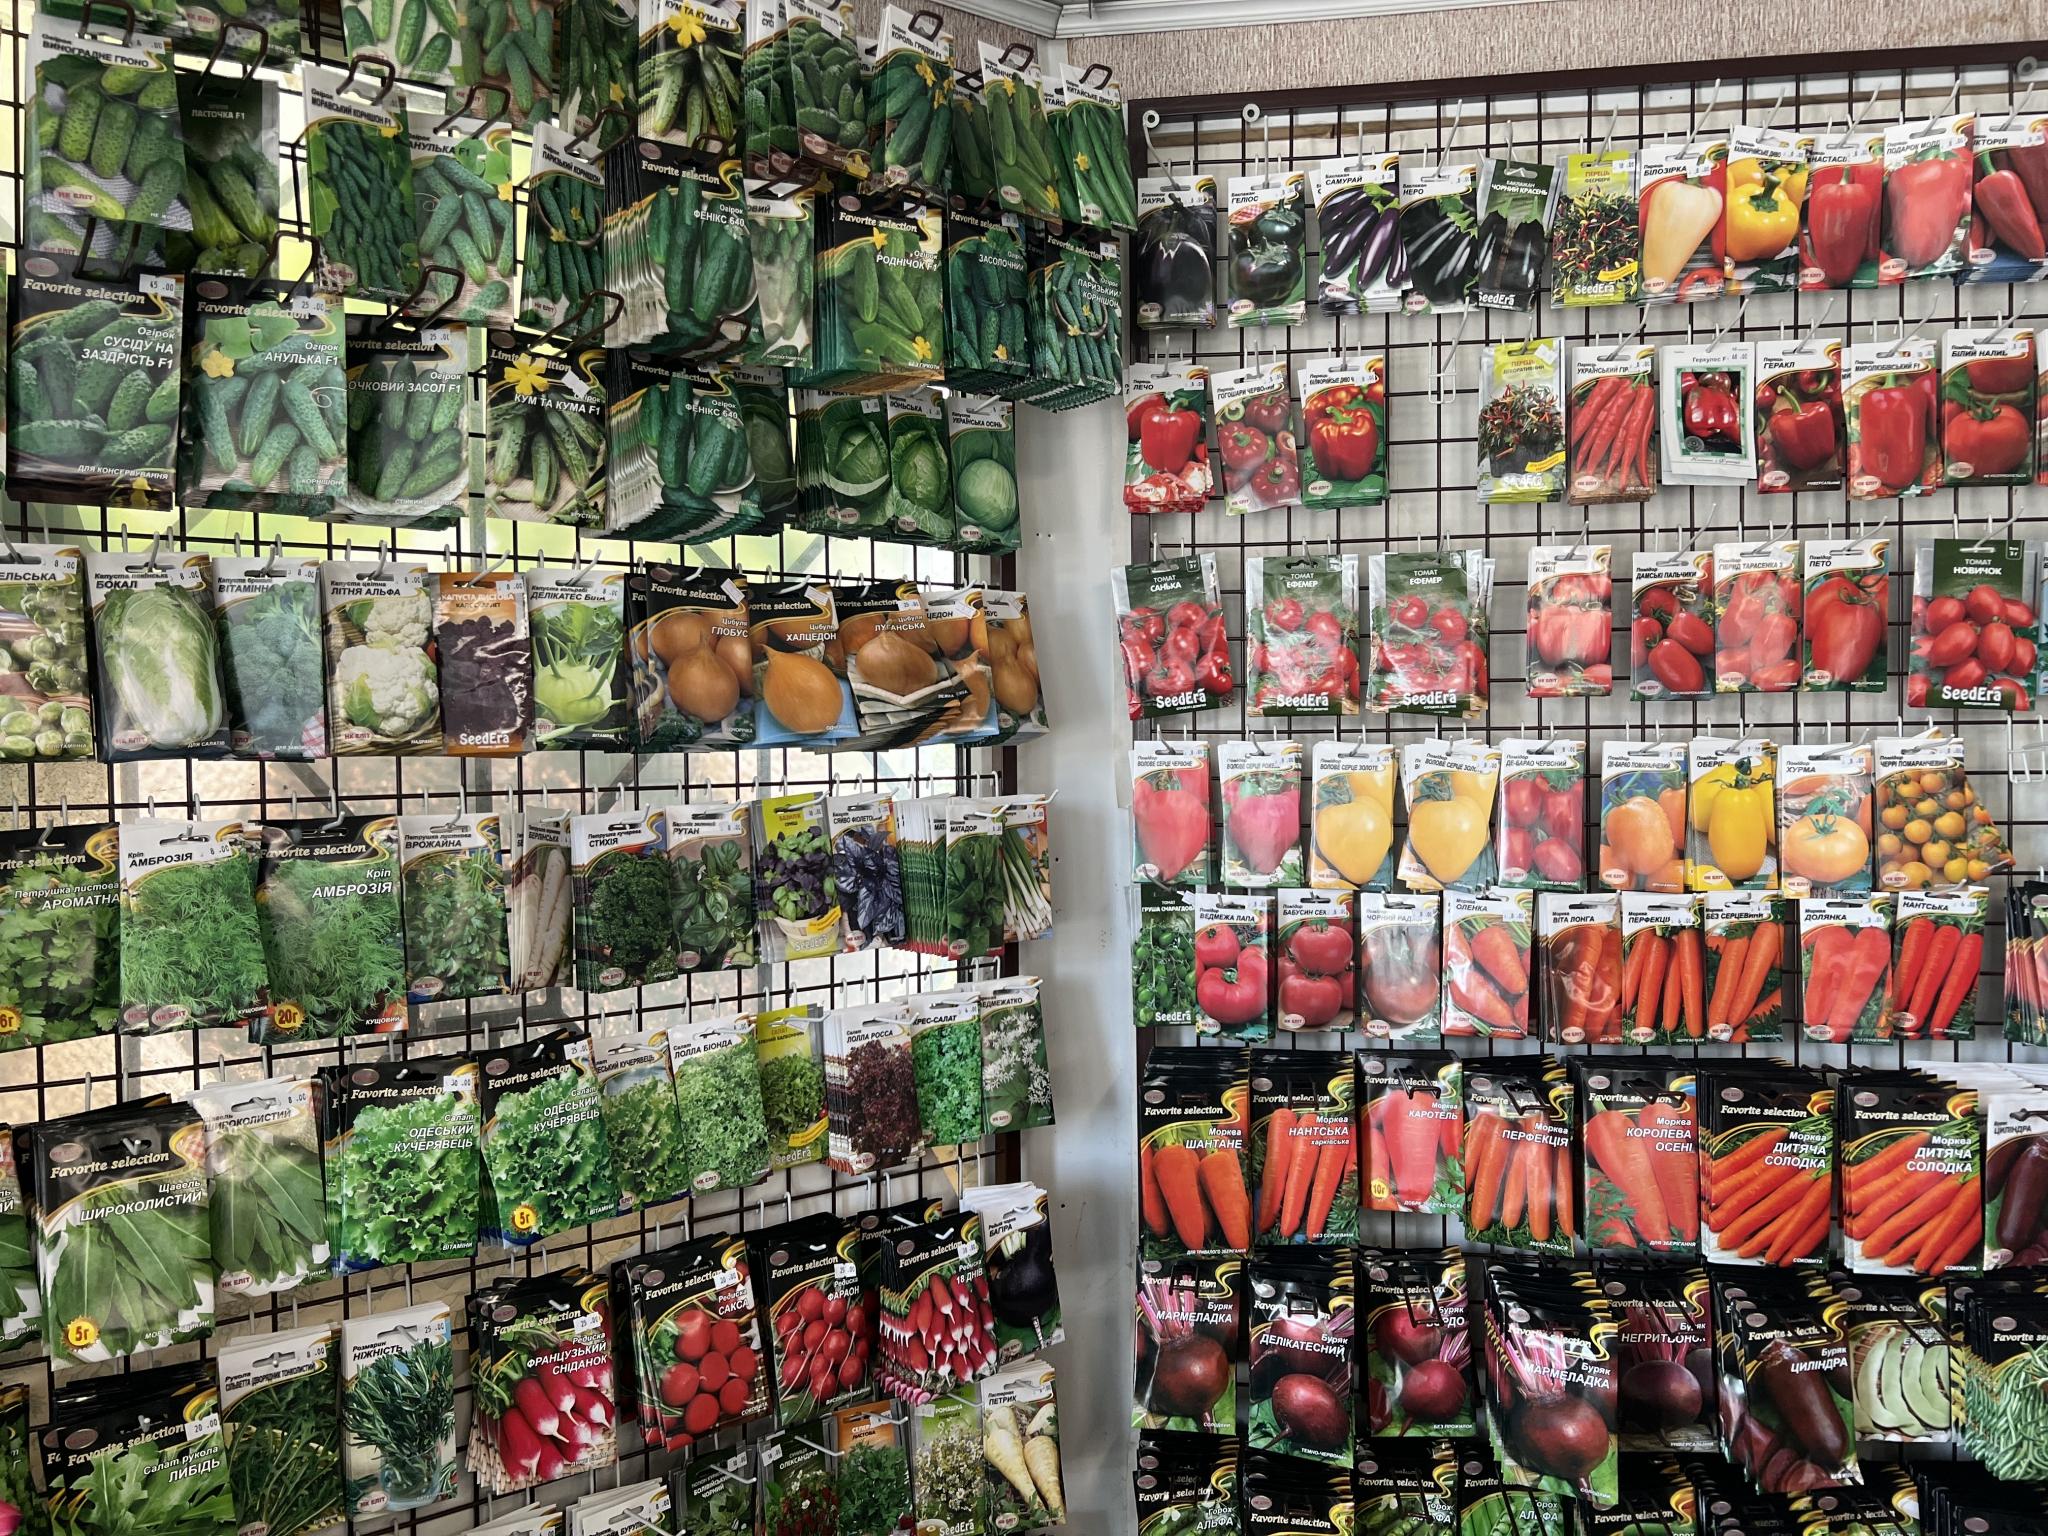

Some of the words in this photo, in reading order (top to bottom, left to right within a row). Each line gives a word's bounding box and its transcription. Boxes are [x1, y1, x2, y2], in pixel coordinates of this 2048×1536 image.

[114, 56, 149, 68] ГРОНО
[192, 110, 232, 119] ЛАСТОЧКА
[235, 111, 245, 120] F1
[1887, 144, 1918, 154] ПОДАРОК
[1326, 176, 1362, 185] САМУРАЙ
[1492, 183, 1519, 193] ЧОРНИЙ
[1520, 187, 1548, 196] КРАСЕНЬ
[719, 204, 743, 214] Огірок
[693, 209, 728, 225] ФЕНІКС
[729, 217, 745, 227] 640
[839, 212, 876, 226] Favorite
[878, 220, 917, 233] selection
[876, 254, 922, 269] РОДНІЧОК
[23, 278, 82, 297] Favorite
[86, 287, 145, 304] selection
[137, 327, 175, 339] Огірок
[104, 336, 154, 352] СУСІДУ
[156, 341, 173, 354] НА
[306, 342, 338, 352] Огірок
[81, 348, 154, 366] ЗАЗДРІСТЬ
[158, 357, 173, 368] F1
[265, 352, 322, 365] АНУЛЬКА
[326, 355, 338, 365] F1
[1763, 361, 1795, 369] ГЕРАКЛ
[431, 372, 461, 381] Огірок
[408, 382, 445, 393] ЗАСОЛ
[448, 383, 460, 393] F1
[515, 393, 538, 405] КУМ
[540, 396, 555, 407] ТА
[556, 399, 586, 412] КУМА
[588, 404, 601, 415] F1
[711, 400, 736, 408] Огірок
[685, 404, 719, 418] ФЕНІКС
[722, 410, 738, 419] 640
[1636, 572, 1663, 580] ДАМСЬКІ
[1665, 571, 1696, 579] ПАЛЬЧИКИ
[1953, 566, 2002, 575] НОВИЧОК
[96, 580, 138, 589] БОКАЛ
[1154, 575, 1176, 583] ТОМАТ
[1286, 580, 1318, 589] ЕФЕМЕР
[1410, 577, 1442, 585] ЕФЕМЕР
[331, 586, 362, 597] ЛІТНЯ
[365, 588, 401, 597] АЛЬФА
[1150, 582, 1182, 592] САНЬКА
[531, 591, 583, 601] ДЕЛІКАТЕС
[722, 617, 747, 627] Цибуля
[810, 623, 834, 632] Цибуля
[875, 622, 926, 632] ЛУГАНСЬКА
[711, 626, 748, 638] ГЛОБУС
[786, 630, 836, 642] ХАЛЦЕДОН
[673, 827, 699, 835] РУТАН
[405, 839, 462, 848] ВРОЖАЙНА
[589, 838, 618, 847] СТИХІЯ
[314, 843, 366, 856] selection
[130, 852, 193, 868] АМБРОЗІЯ
[366, 869, 391, 880] Кріп
[15, 886, 71, 899] Петрушка
[312, 881, 392, 899] АМБРОЗІЯ
[42, 894, 120, 911] АРОМАТНА
[1456, 904, 1488, 912] ОЛЕНКА
[1903, 901, 1949, 911] НАНТСЬКА
[1200, 913, 1234, 921] ВЕДМЕЖА
[1236, 914, 1255, 922] ЛАПА
[1570, 915, 1595, 923] ЛОНГА
[1805, 913, 1846, 921] ДОЛЯНКА
[278, 1011, 297, 1026] 20г
[847, 1033, 868, 1043] ЛОЛЛА
[870, 1030, 893, 1039] РОССА
[699, 1040, 729, 1053] БІОНДА
[543, 1095, 598, 1117] ОДЕСЬКИЙ
[1145, 1106, 1182, 1116] Favorite
[1184, 1106, 1223, 1115] selection
[1431, 1102, 1457, 1110] Морква
[1721, 1105, 1761, 1116] Favorite
[1763, 1107, 1807, 1118] selection
[445, 1114, 474, 1123] Салат
[534, 1109, 600, 1133] КУЧЕРЯВЕЦЬ
[1316, 1115, 1348, 1124] Морква
[1408, 1110, 1457, 1120] КАРОТЕЛЬ
[1855, 1110, 1900, 1120] Favorite
[1903, 1111, 1949, 1122] selection
[1656, 1117, 1691, 1127] Морква
[409, 1124, 474, 1138] ОДЕСЬКИЙ
[1209, 1127, 1241, 1137] Морква
[1289, 1126, 1349, 1137] НАНТСЬКА
[1535, 1123, 1568, 1135] Морква
[1626, 1127, 1691, 1139] КОРОЛЕВА
[1502, 1129, 1568, 1147] ПЕРФЕКЦІЯ
[1789, 1132, 1827, 1142] Морква
[1932, 1136, 1972, 1146] Морква
[393, 1138, 473, 1153] КУЧЕРЯВЕЦЬ
[1185, 1138, 1242, 1149] ШАНТАНЕ
[1655, 1141, 1693, 1152] ОСЕНІ
[1773, 1143, 1827, 1156] ДИТЯЧА
[1915, 1147, 1972, 1160] ДИТЯЧА
[50, 1161, 107, 1178] Favorite
[111, 1151, 169, 1167] selection
[1764, 1156, 1826, 1169] СОЛОДКА
[1907, 1161, 1972, 1173] СОЛОДКА
[159, 1179, 201, 1192] Щавель
[81, 1190, 202, 1221] ШИРОКОЛИСТИЙ
[989, 1224, 1013, 1237] БАГІРА
[956, 1274, 964, 1284] 18
[965, 1268, 983, 1282] ДНІВ
[828, 1286, 860, 1302] ФАРАОН
[719, 1299, 749, 1315] САКСА
[1208, 1301, 1233, 1311] Буряк
[540, 1309, 581, 1325] selection
[1157, 1311, 1232, 1323] МАРМЕЛАДКА
[75, 1328, 90, 1341] 5г
[572, 1331, 605, 1345] Редиска
[1321, 1333, 1348, 1345] Буряк
[1260, 1333, 1346, 1358] ДЕЛІКАТЕСНИЙ
[353, 1344, 403, 1362] НІЖНІСТЬ
[526, 1341, 606, 1369] ФРАНЦУЗЬКИЙ
[1822, 1347, 1847, 1357] Буряк
[552, 1354, 608, 1376] СНІДАНОК
[1581, 1361, 1611, 1375] Буряк
[1791, 1357, 1848, 1373] ЦИЛІНДРА
[1524, 1363, 1610, 1390] МАРМЕЛАДКА
[988, 1395, 1017, 1406] ПЕТРИК
[143, 1460, 180, 1476] Салат
[182, 1446, 218, 1463] рукола
[168, 1459, 220, 1484] ЛИБІДЬ
[1197, 1517, 1233, 1531] АЛЬФА
[1251, 1513, 1288, 1526] Favorite
[1291, 1517, 1331, 1529] selection
